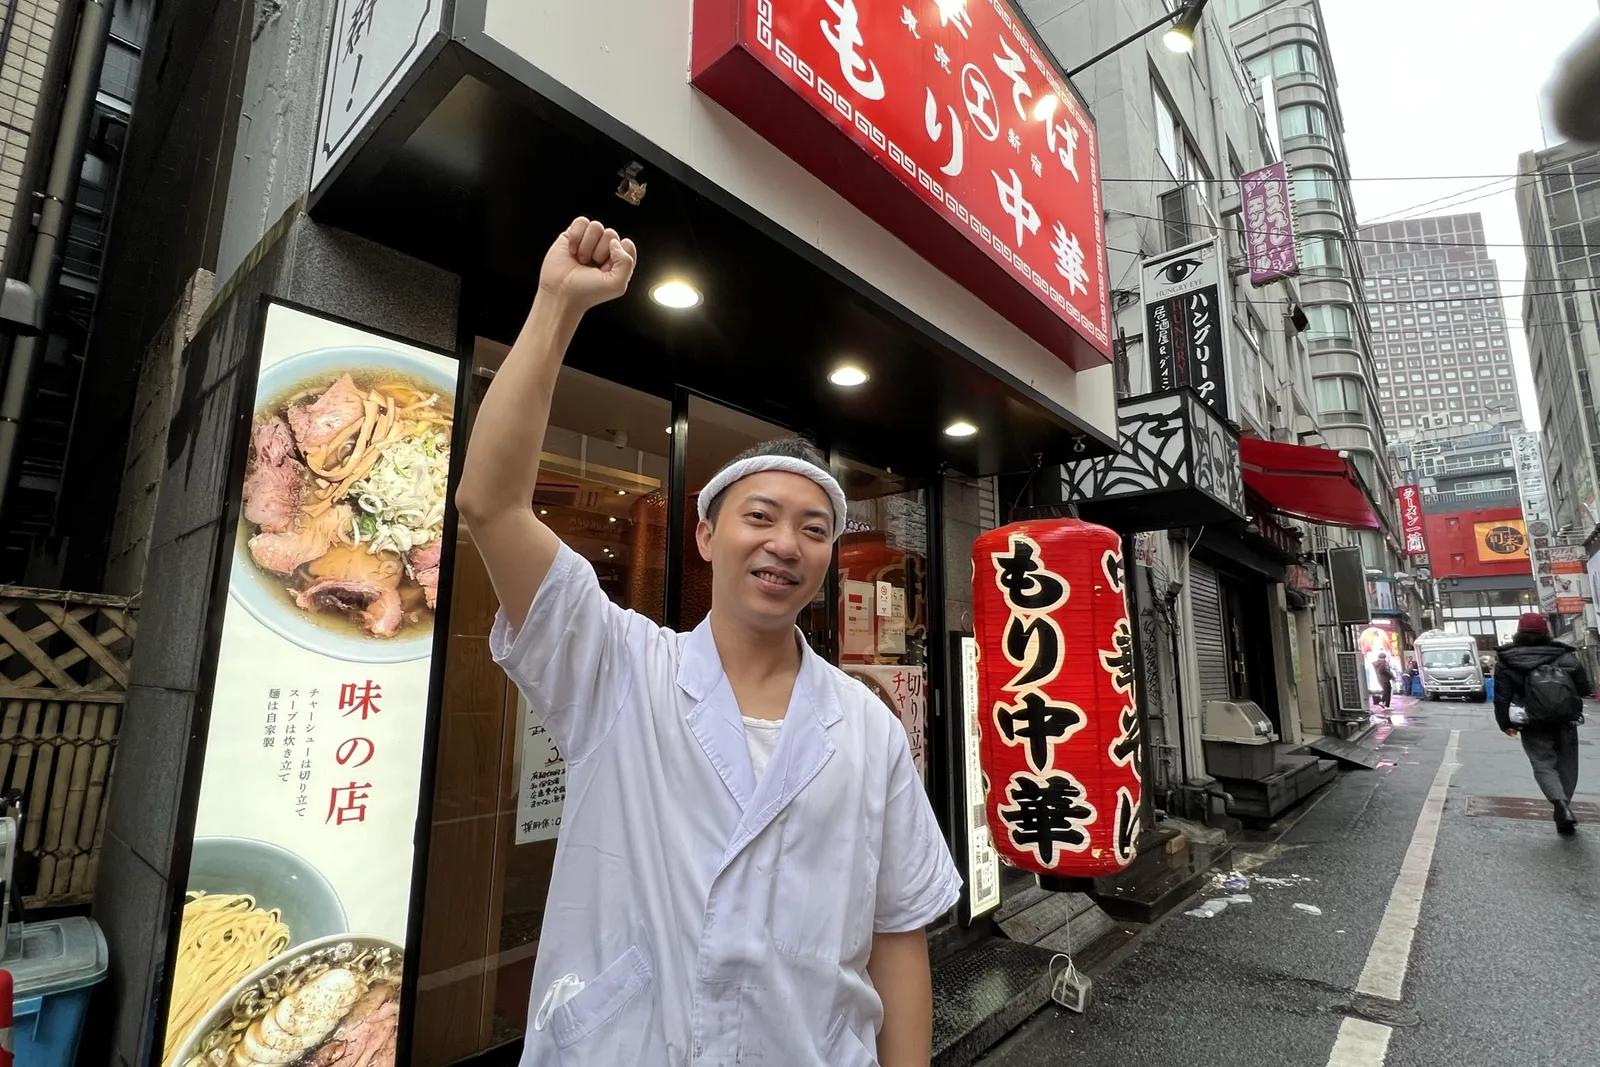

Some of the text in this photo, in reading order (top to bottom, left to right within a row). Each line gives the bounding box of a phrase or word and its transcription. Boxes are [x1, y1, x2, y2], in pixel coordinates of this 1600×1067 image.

[819, 0, 1089, 296] もり中華
[900, 5, 951, 74] 東京
[1008, 128, 1042, 178] 新宿
[1155, 278, 1204, 298] HUNGRY EYE
[262, 688, 281, 748] 麺は自家製
[277, 689, 300, 782] スープは炊き立て
[295, 688, 320, 817] チャーシューは切り立て
[325, 680, 382, 825] 味の店
[994, 537, 1094, 867] もり中華
